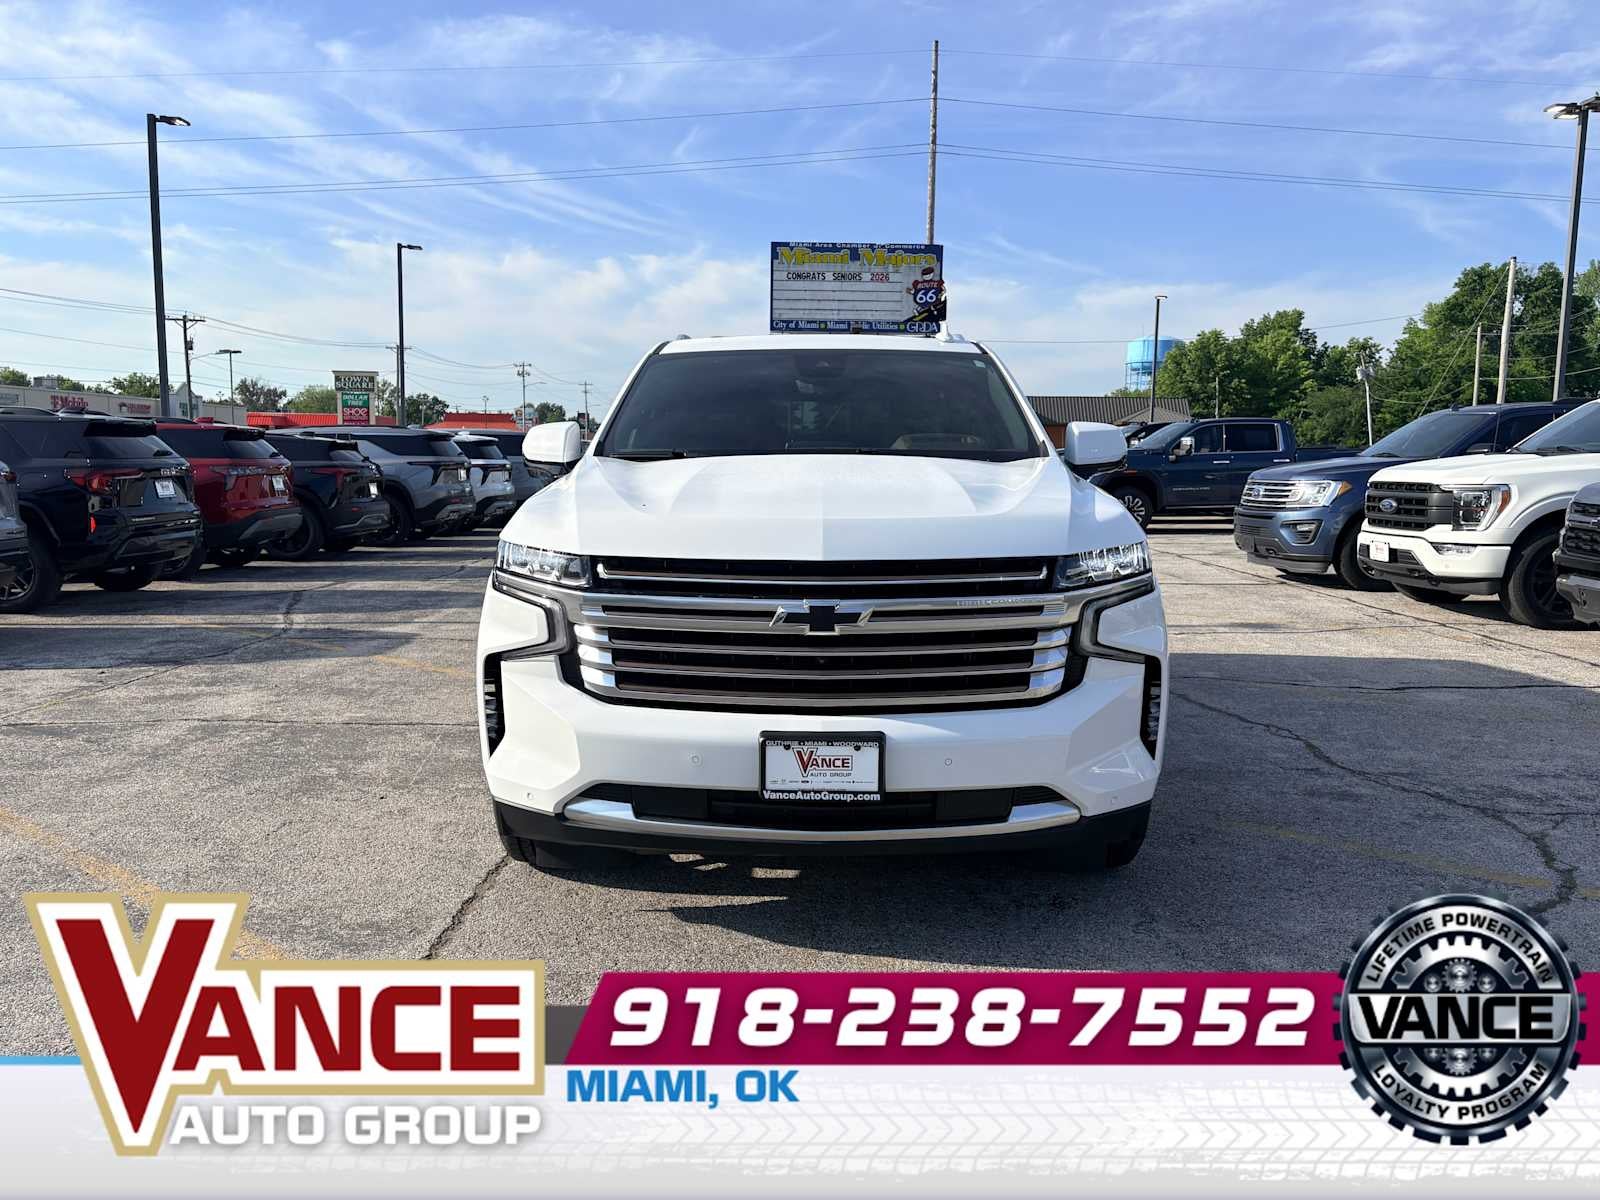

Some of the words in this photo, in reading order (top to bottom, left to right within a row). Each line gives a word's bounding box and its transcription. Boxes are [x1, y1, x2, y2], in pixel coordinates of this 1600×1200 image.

[777, 246, 850, 265] Miami
[858, 247, 937, 267] Majors
[786, 272, 826, 281] CONGRATS
[832, 273, 863, 281] SENIORS
[870, 273, 890, 282] 2026
[915, 289, 936, 304] 66
[773, 320, 787, 329] City
[798, 320, 819, 329] Miami
[826, 321, 848, 329] Miami
[872, 321, 898, 330] Utilities
[335, 381, 375, 389] SQUARE
[795, 748, 851, 776] VANCE
[763, 790, 881, 802] VanceAutoGroup.com
